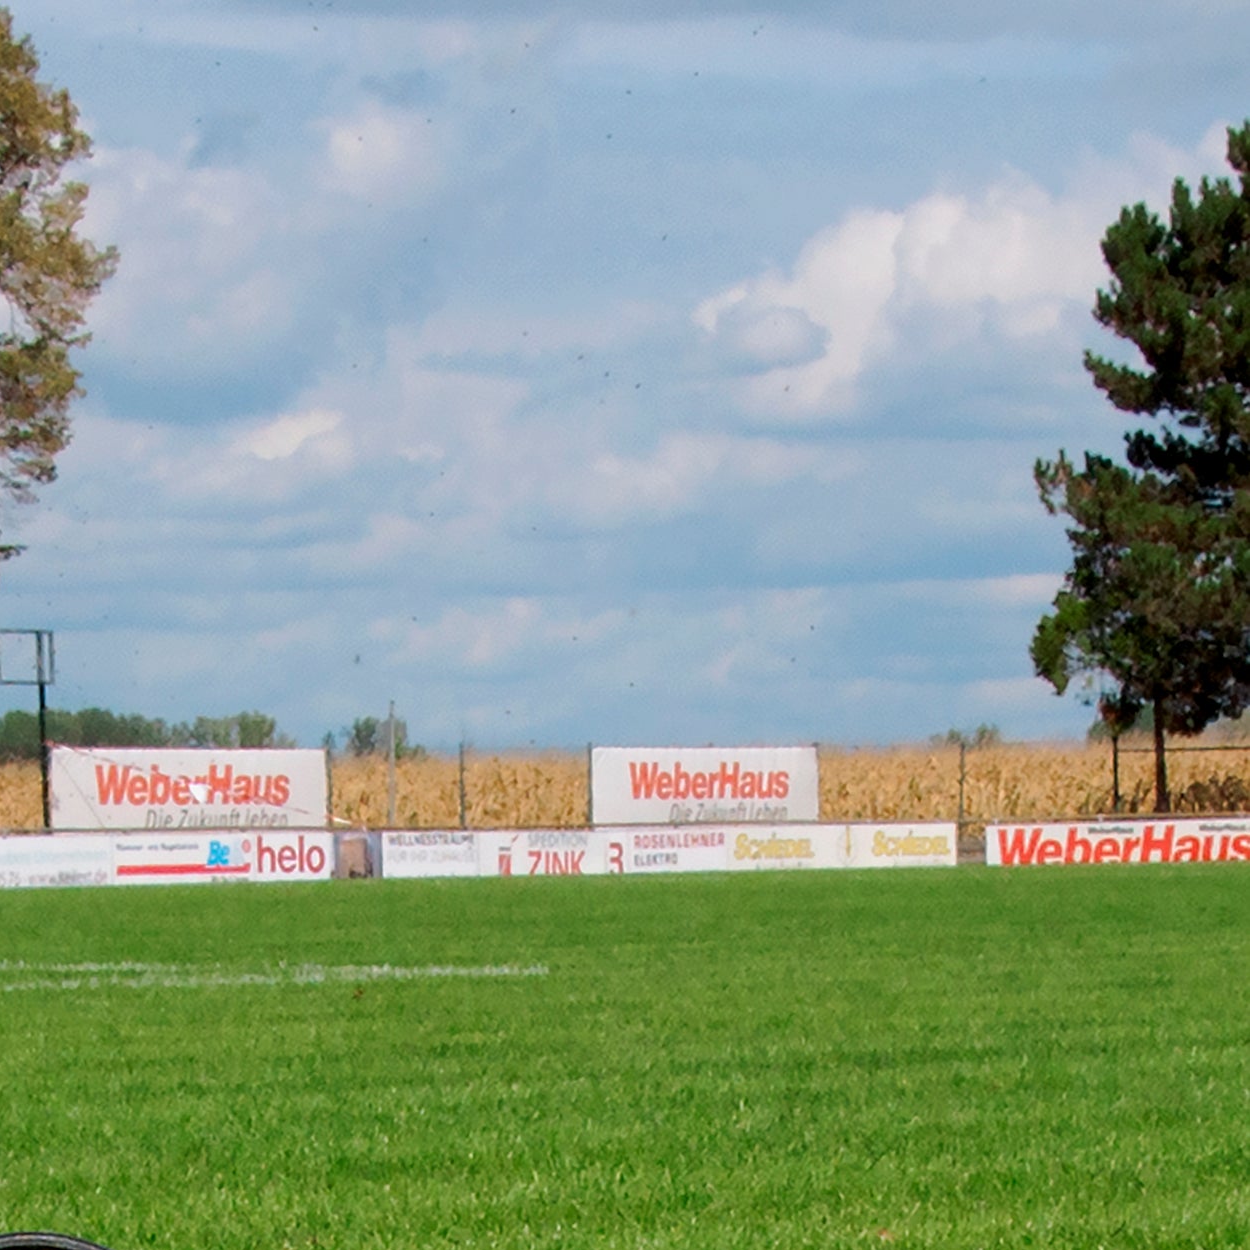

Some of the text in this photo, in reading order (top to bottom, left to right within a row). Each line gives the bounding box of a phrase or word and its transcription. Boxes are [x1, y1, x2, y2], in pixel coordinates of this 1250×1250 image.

[628, 761, 789, 800] WeberHaus
[256, 835, 325, 874] helo
[634, 832, 725, 849] ROSENLEHNER
[997, 825, 1250, 867] WeberHaus
[527, 849, 585, 875] ZINK
